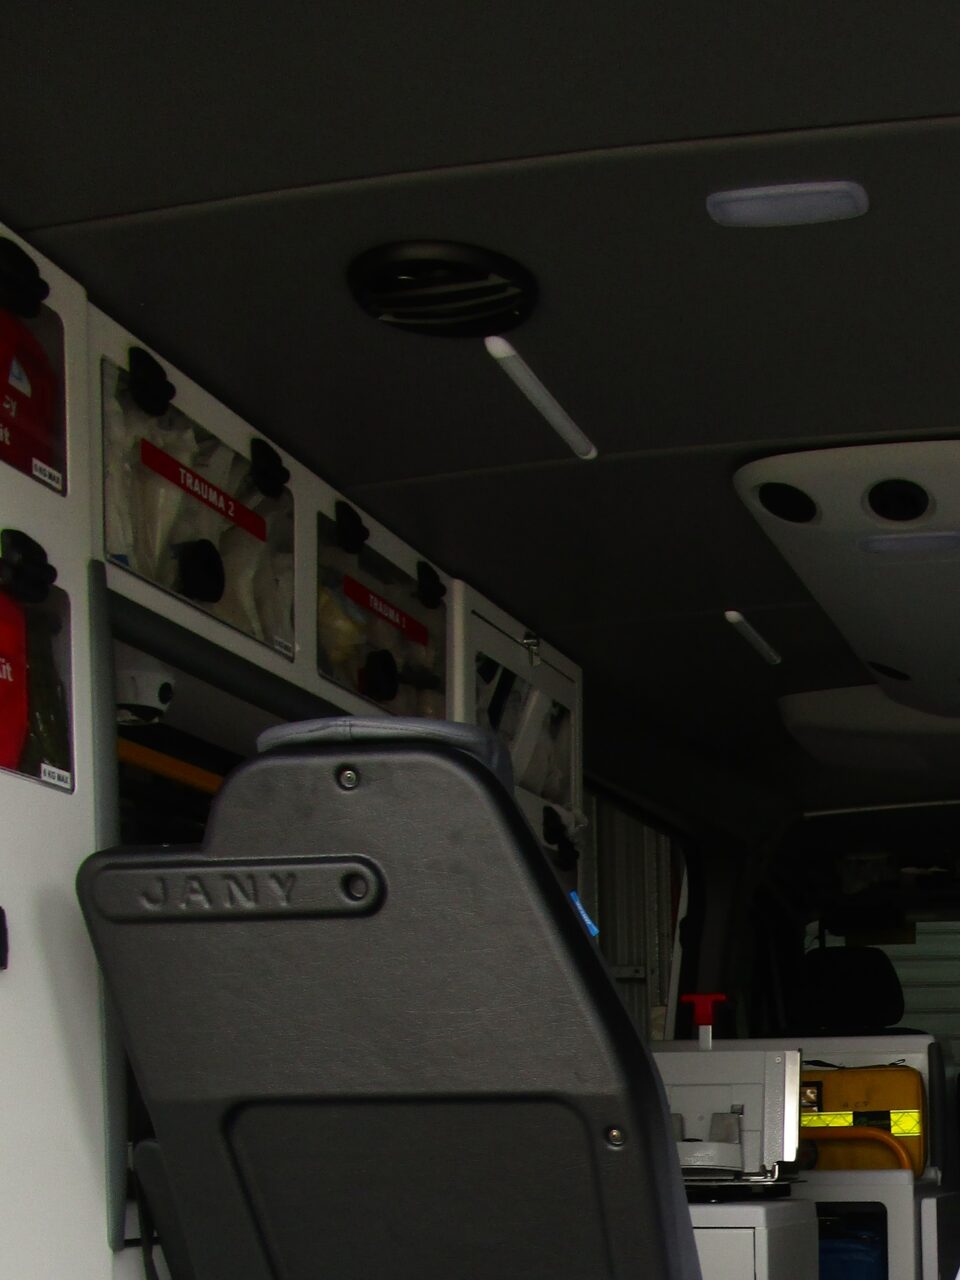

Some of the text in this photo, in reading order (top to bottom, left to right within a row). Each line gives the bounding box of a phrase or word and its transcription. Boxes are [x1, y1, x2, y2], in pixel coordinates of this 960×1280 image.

[178, 467, 235, 517] TRAUMA 2
[368, 593, 400, 624] TRAUMA
[57, 773, 69, 783] MAX
[138, 872, 296, 910] JANY
